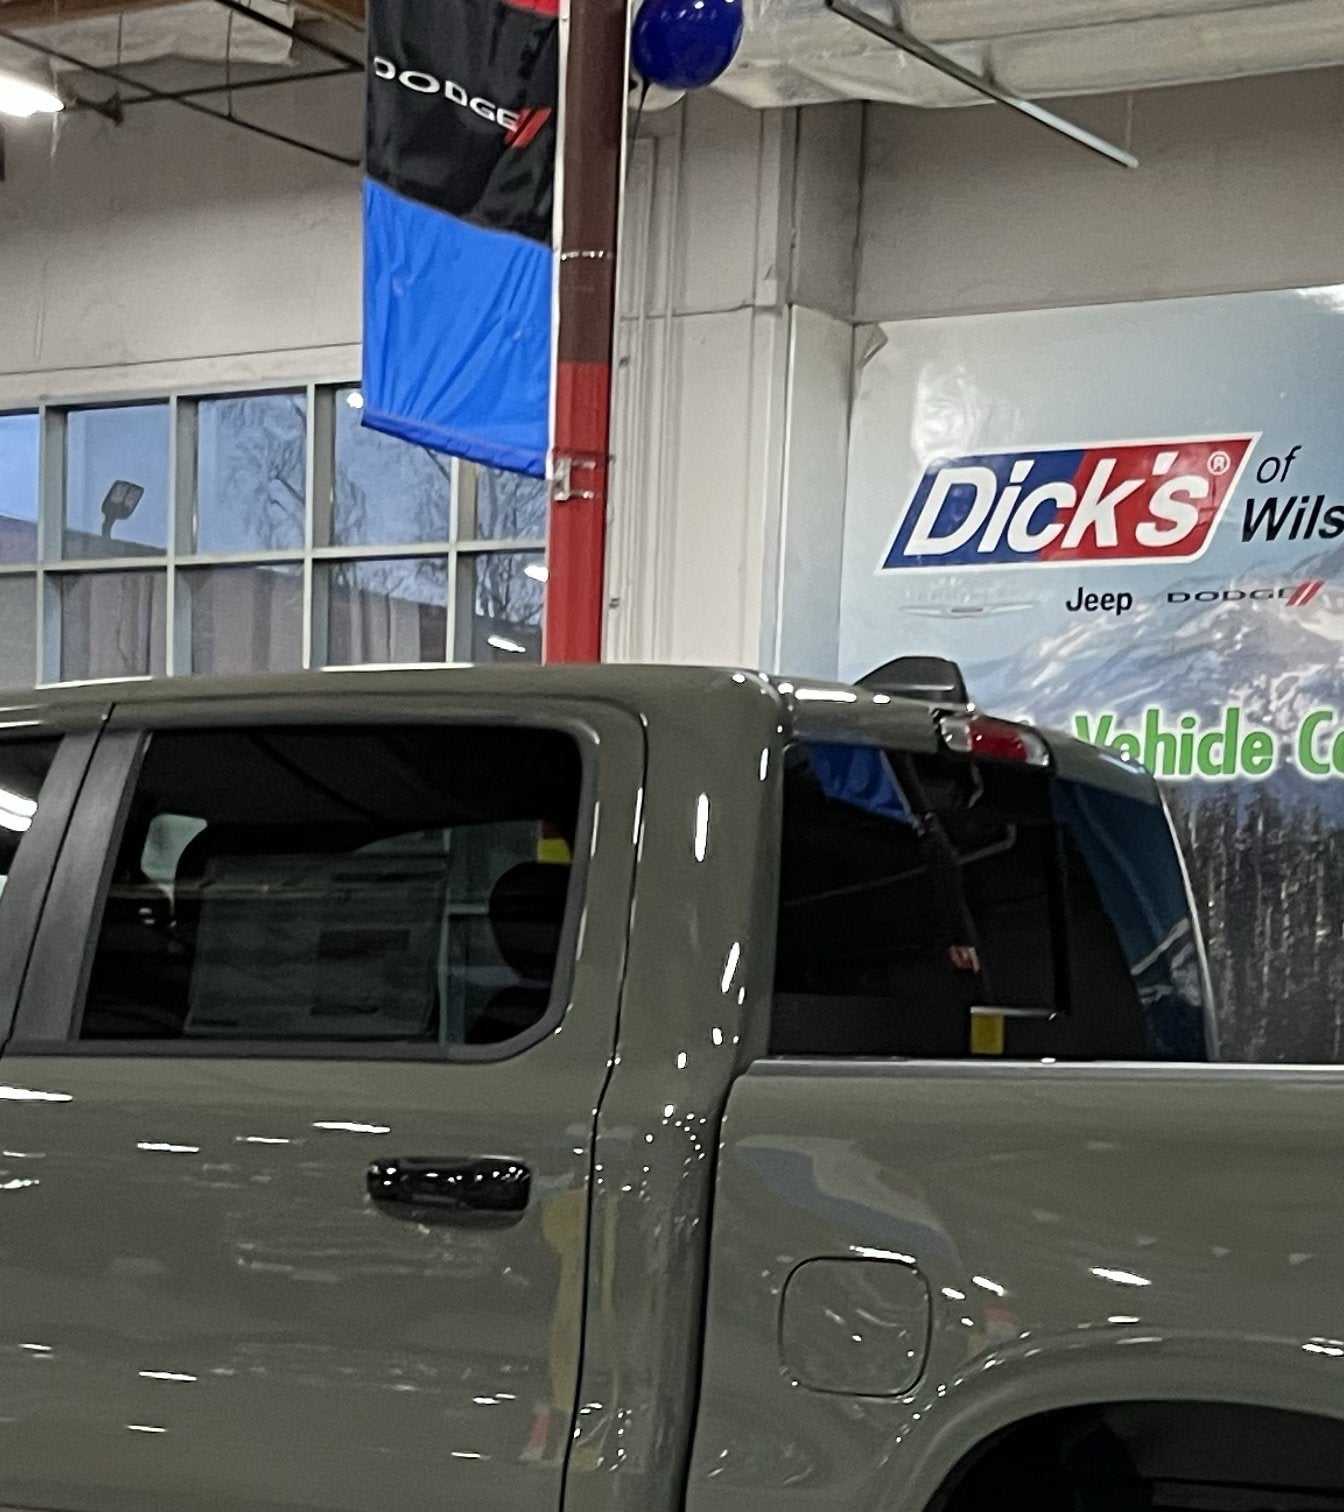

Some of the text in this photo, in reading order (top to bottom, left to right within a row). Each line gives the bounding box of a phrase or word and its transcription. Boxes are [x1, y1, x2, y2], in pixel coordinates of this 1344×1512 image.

[373, 55, 522, 132] DODGE
[902, 444, 1303, 556] Dick's of
[1065, 586, 1133, 616] Jeep
